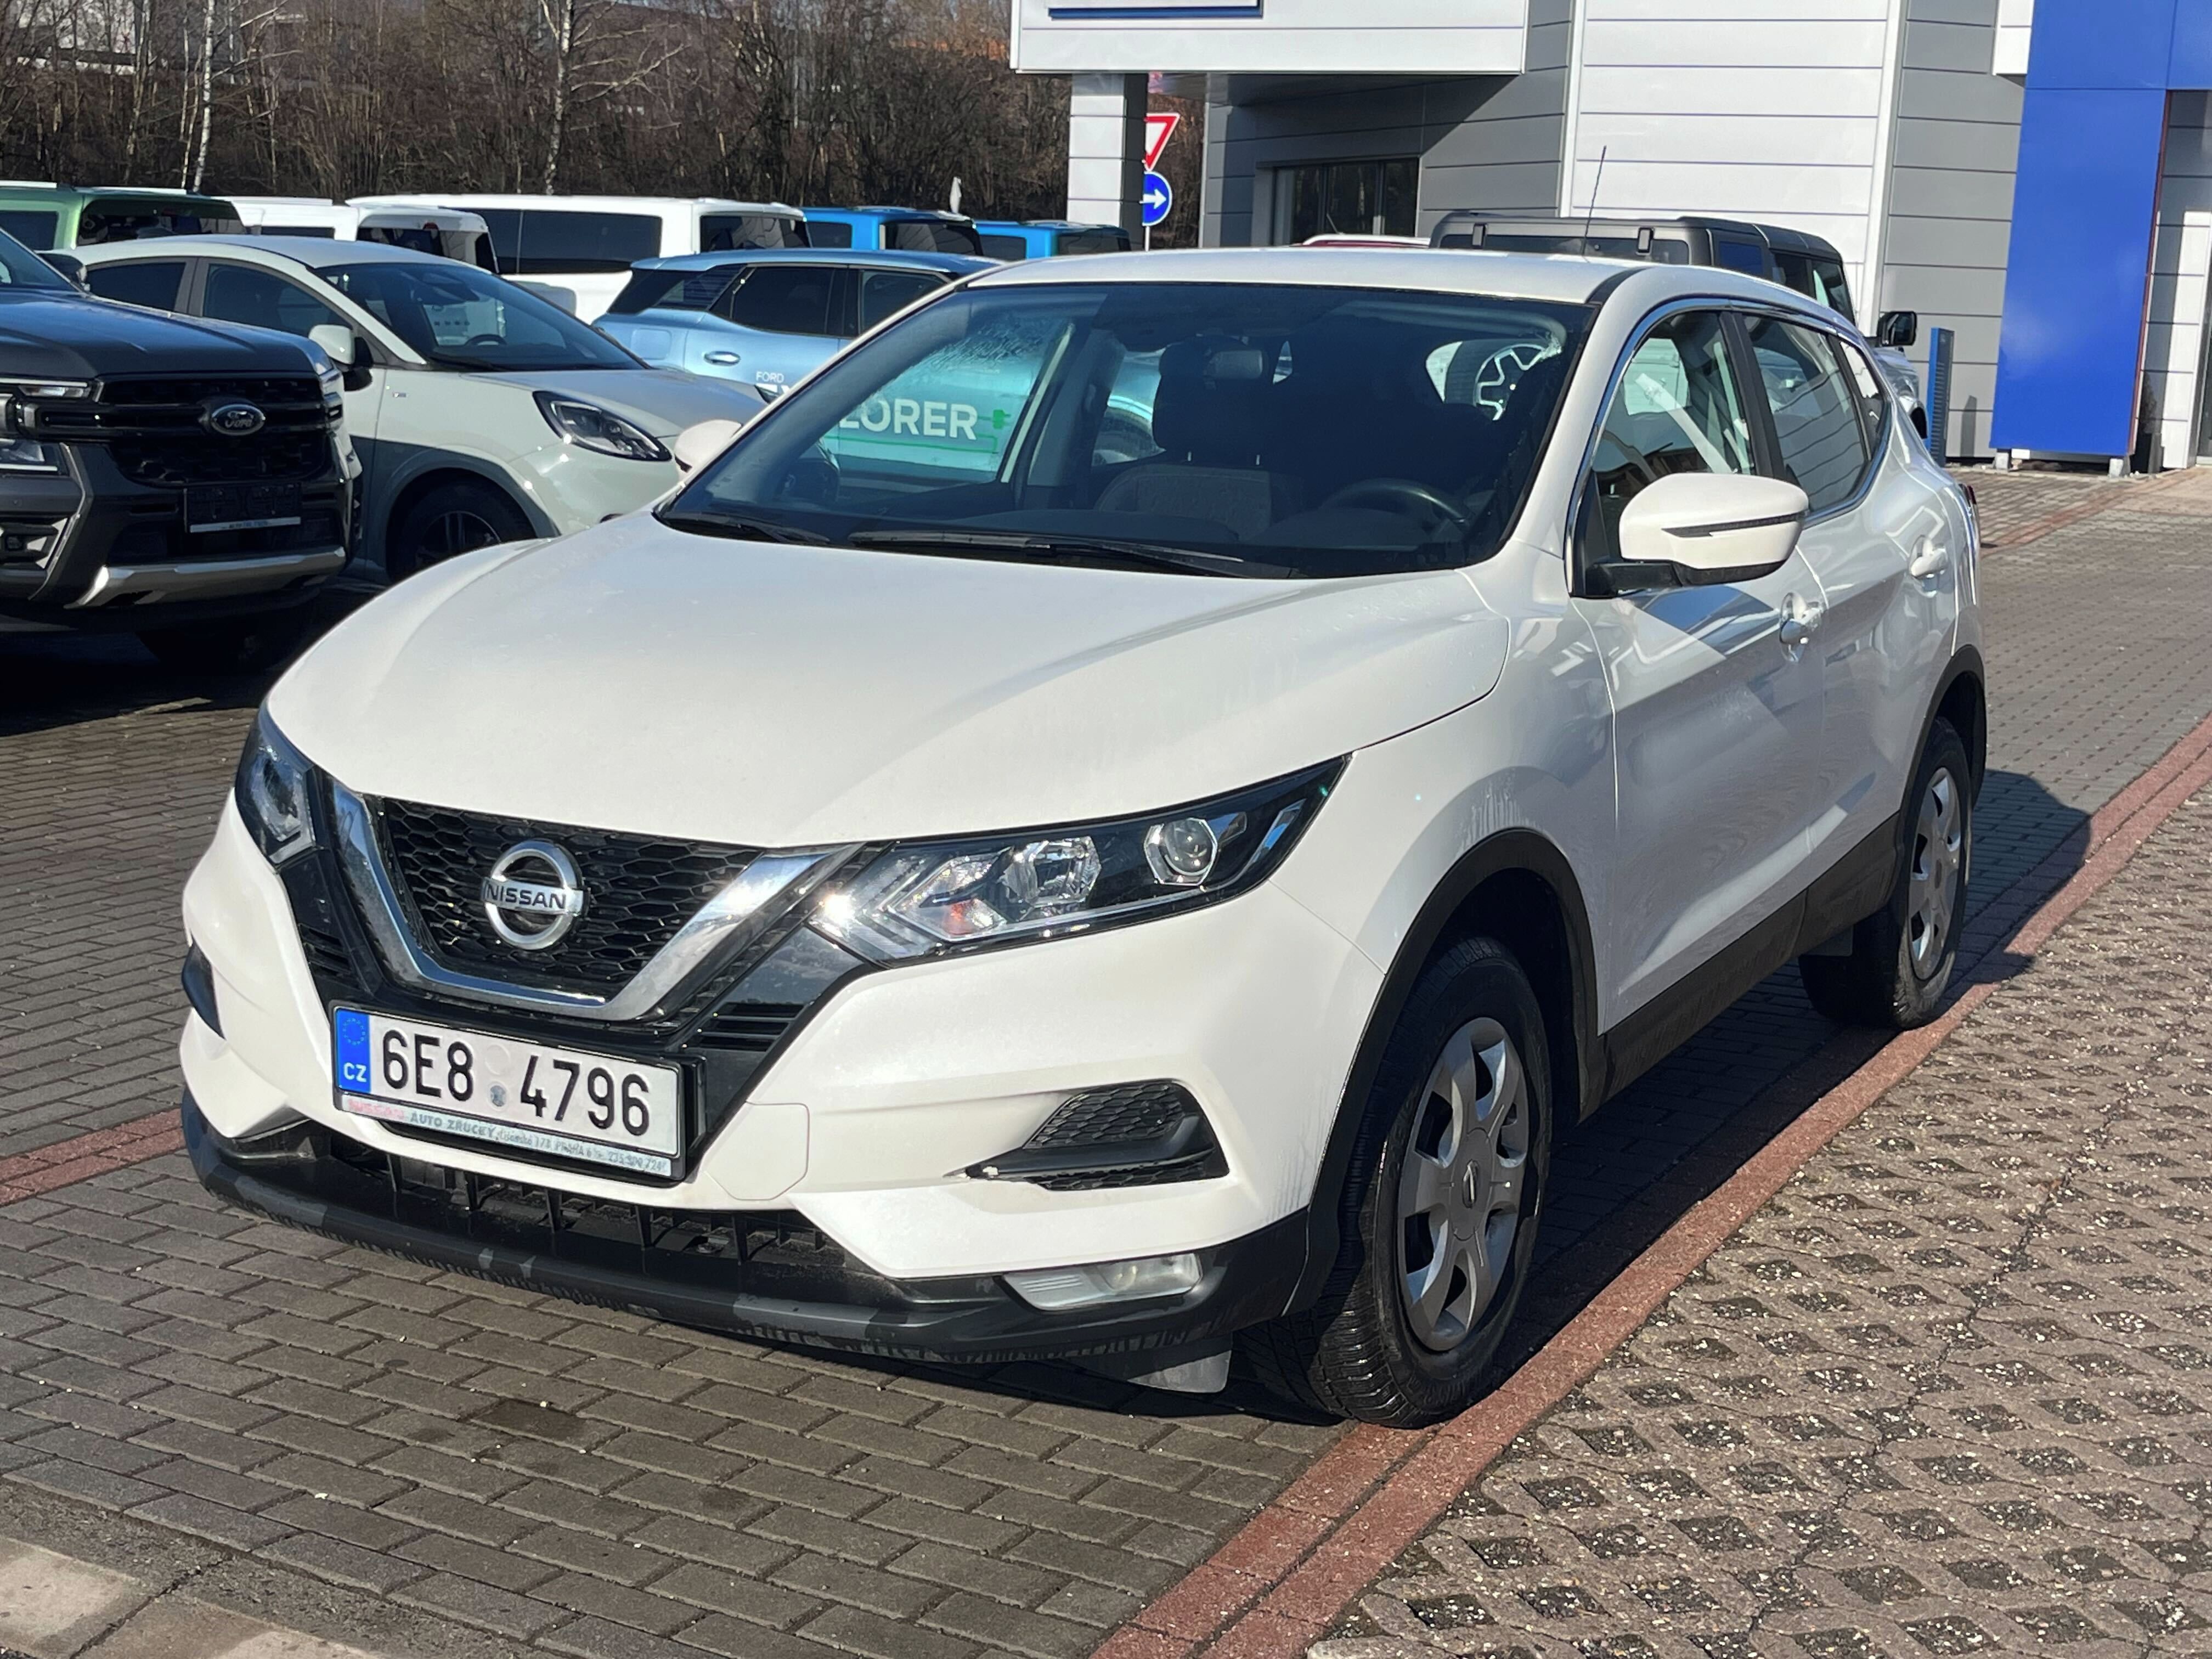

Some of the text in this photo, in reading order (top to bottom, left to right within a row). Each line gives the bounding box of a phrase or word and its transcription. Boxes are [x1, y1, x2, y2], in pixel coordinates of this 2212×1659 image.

[755, 371, 785, 383] FORD
[484, 881, 566, 910] NISSAN
[343, 1062, 367, 1083] CZ
[382, 1029, 651, 1137] 6E8 4796
[410, 1111, 443, 1126] AUTO
